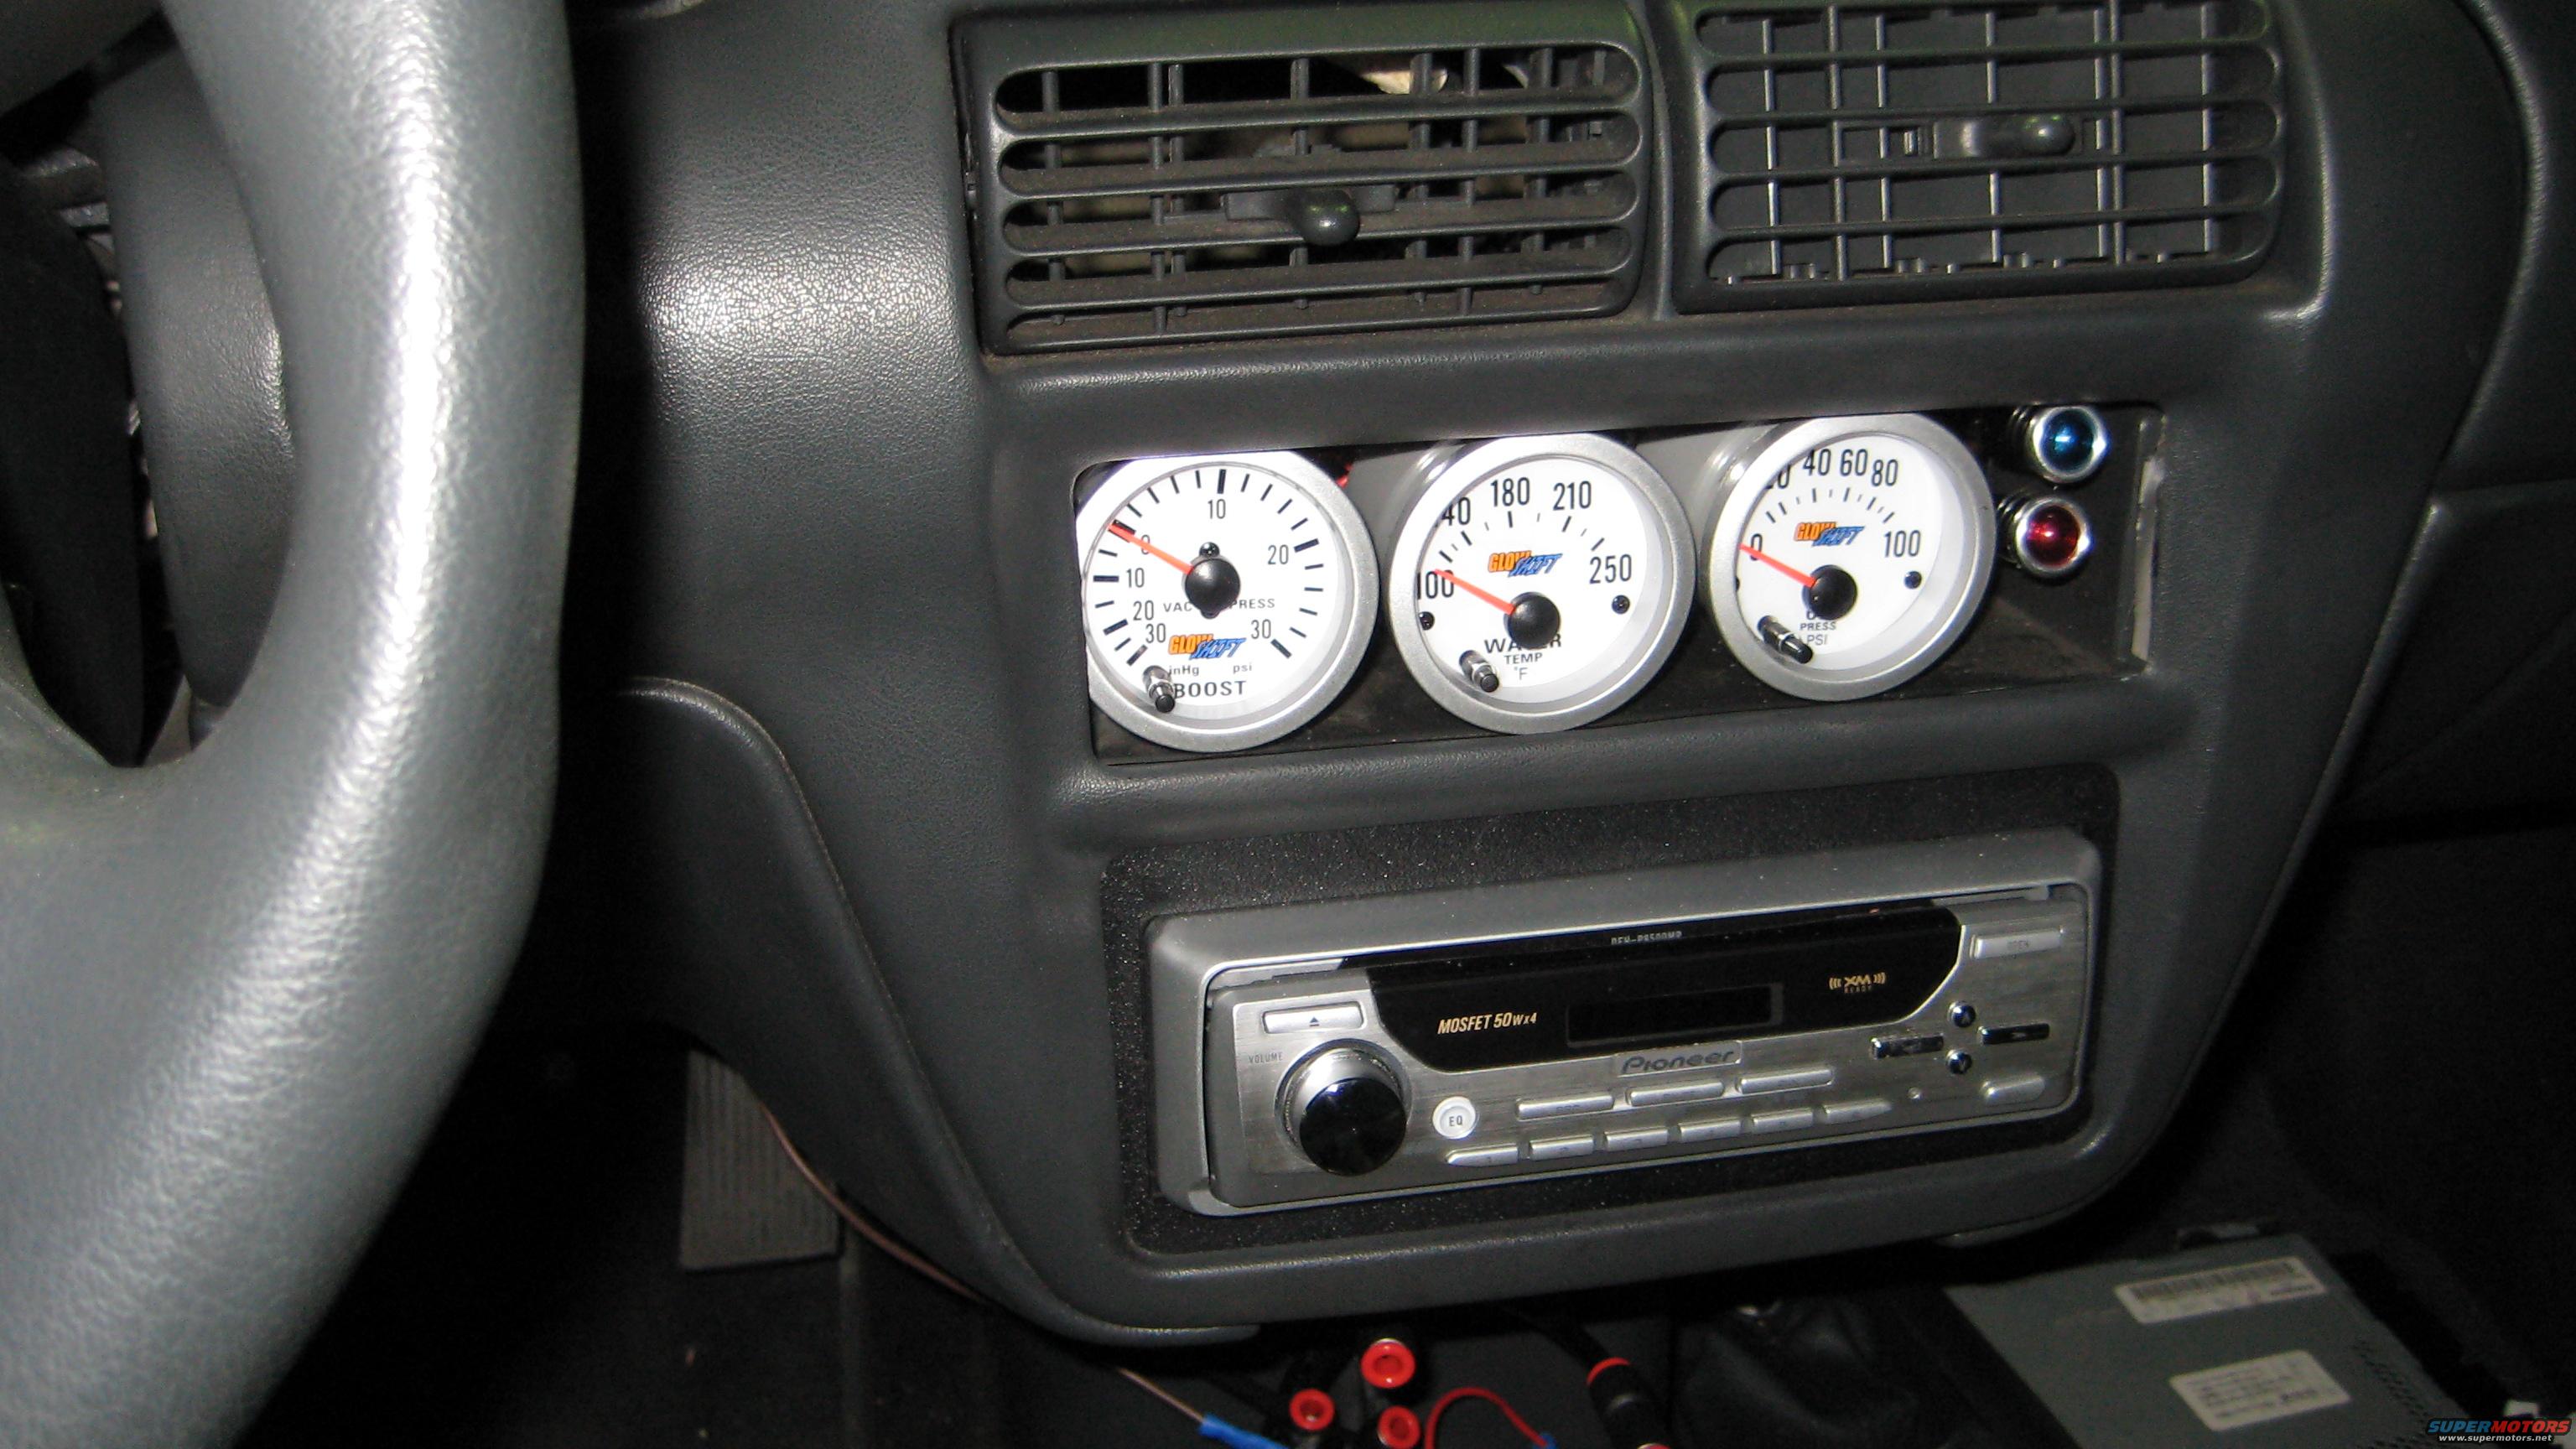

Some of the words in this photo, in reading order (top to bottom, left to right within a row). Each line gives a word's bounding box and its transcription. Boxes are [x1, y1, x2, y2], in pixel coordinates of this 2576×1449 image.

[1802, 448, 1831, 476] 40
[1839, 449, 1868, 476] 60
[1764, 464, 1791, 489] 0
[1871, 459, 1898, 486] 80
[1490, 477, 1530, 507] 180
[1553, 480, 1592, 511] 210
[1208, 499, 1226, 519] 10
[1435, 496, 1471, 526] 40
[1884, 530, 1920, 558] 100
[1268, 544, 1290, 565] 20
[1126, 568, 1145, 588] 10
[1589, 554, 1632, 584] 250
[1416, 569, 1454, 600] 100
[1133, 600, 1154, 621] 20
[1163, 601, 1192, 612] VAC
[1145, 623, 1166, 643] 30
[1250, 619, 1271, 639] 30
[1800, 621, 1836, 631] PRESS
[1233, 662, 1252, 674] psi
[1504, 652, 1543, 665] TEMP
[1174, 680, 1247, 699] BOOST
[1844, 974, 1872, 986] XM
[1437, 1014, 1493, 1034] MOSFET
[1249, 1052, 1283, 1063] VOLUME
[1622, 1051, 1734, 1074] Pioneer
[1448, 1115, 1463, 1127] EQ
